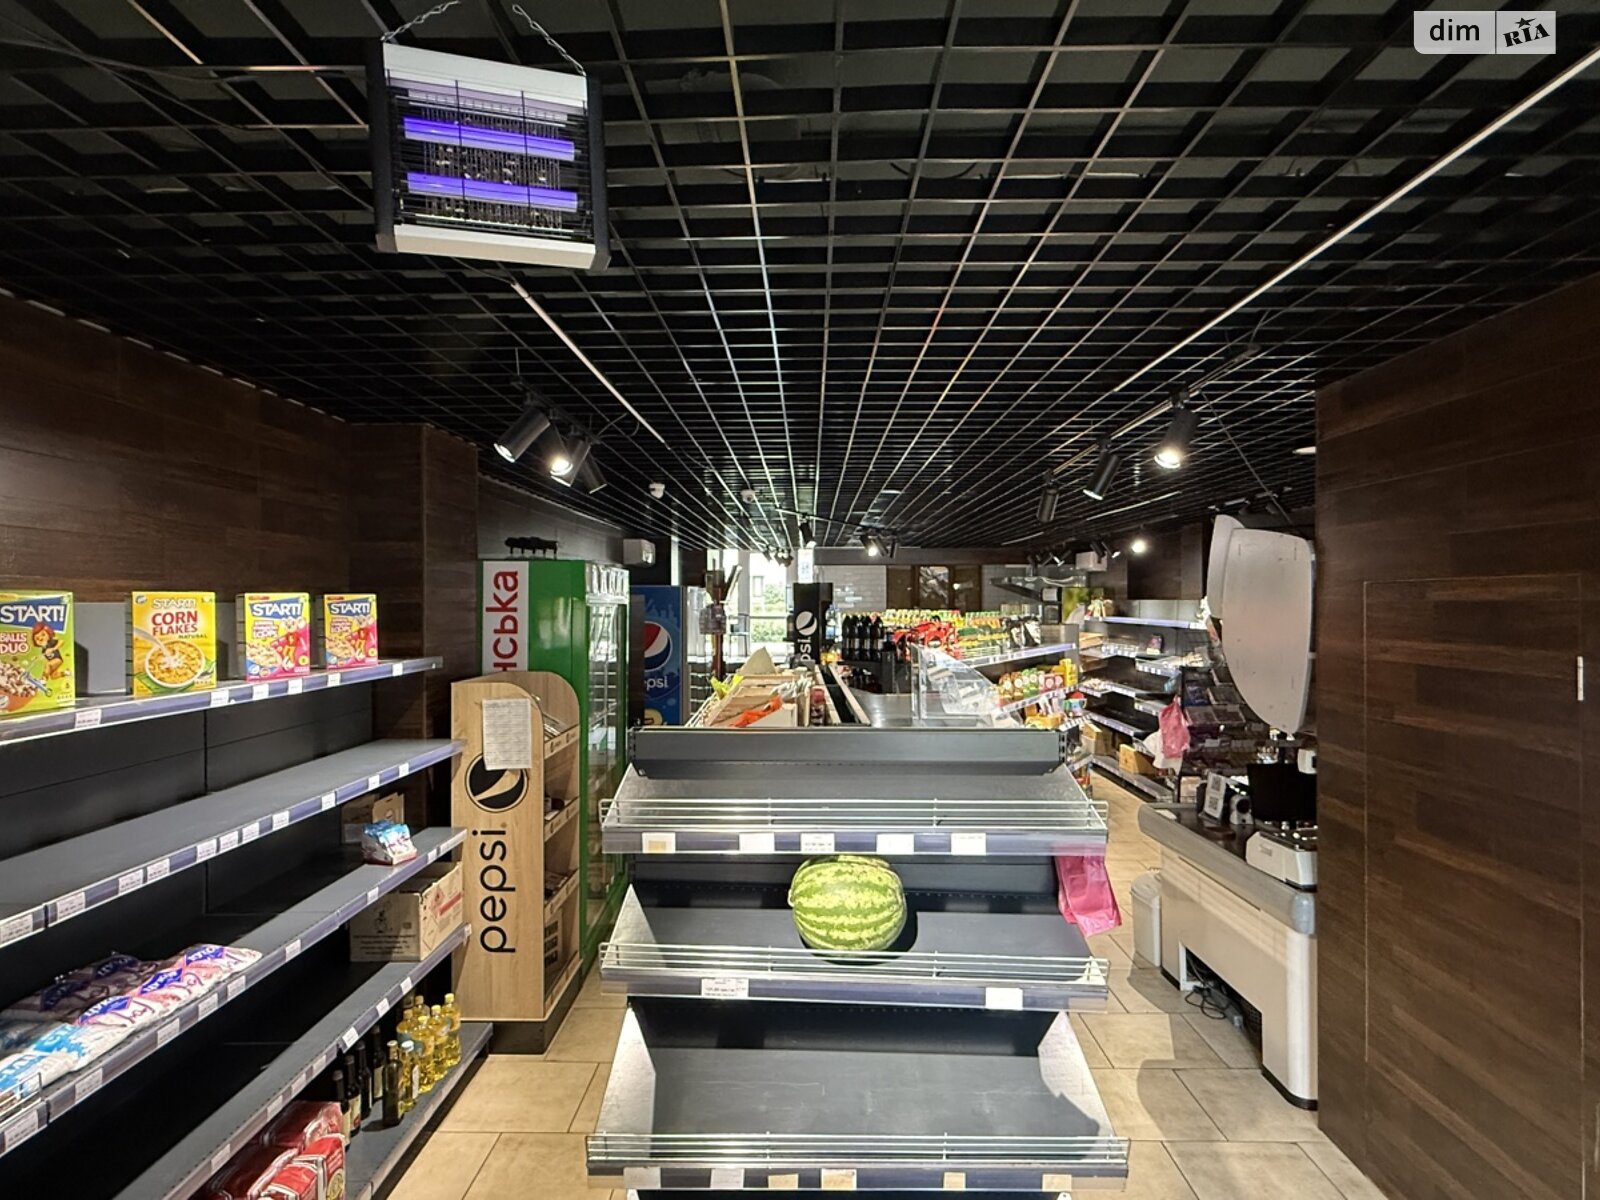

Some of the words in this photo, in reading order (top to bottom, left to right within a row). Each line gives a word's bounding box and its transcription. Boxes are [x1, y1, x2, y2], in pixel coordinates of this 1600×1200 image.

[0, 604, 66, 623] START!
[252, 603, 302, 617] START!
[330, 602, 370, 614] START!
[151, 610, 198, 626] CORN
[153, 623, 198, 636] FLAKES
[0, 643, 29, 654] DUO
[644, 675, 668, 691] psi
[472, 829, 516, 953] pepsi
